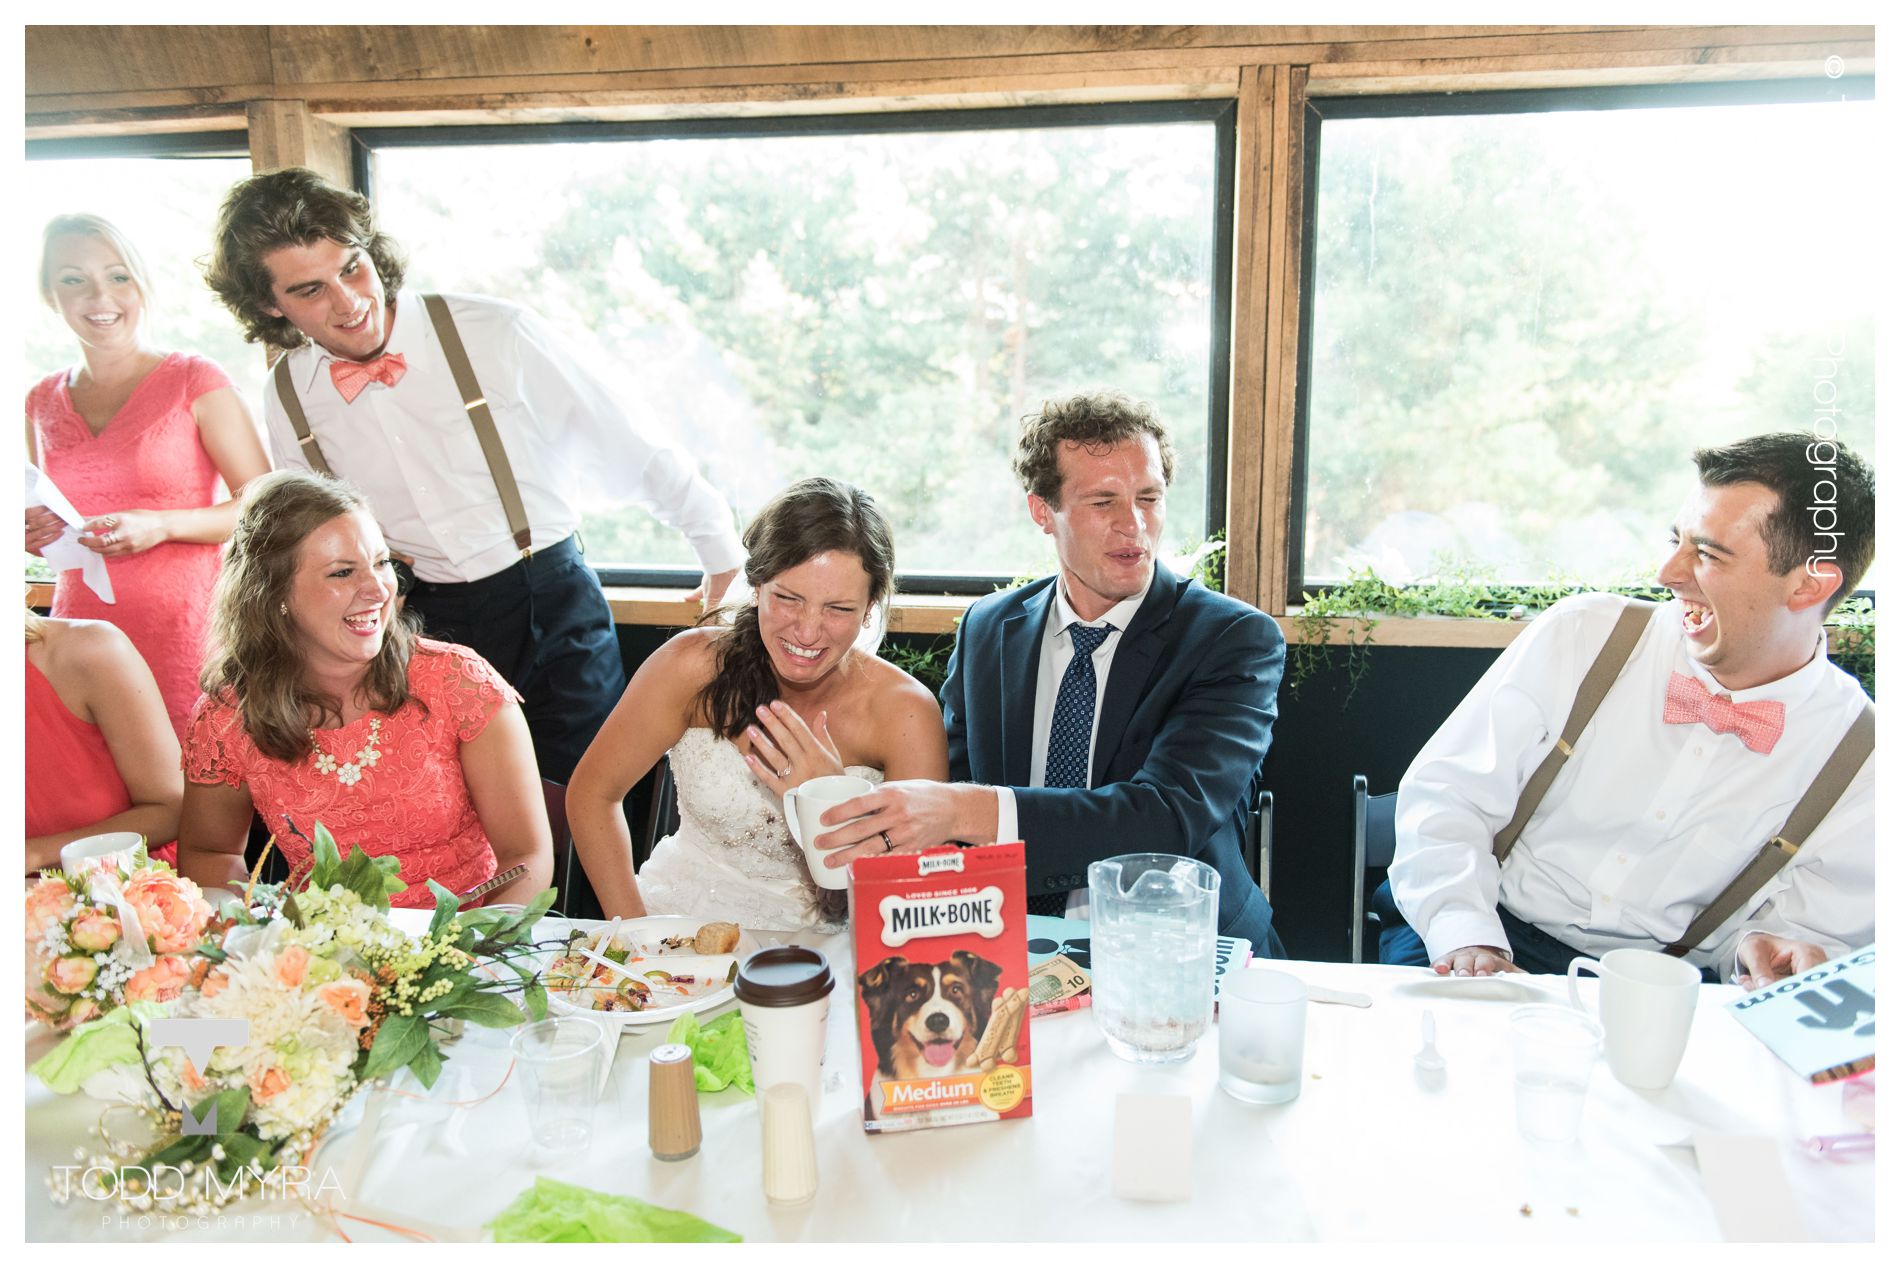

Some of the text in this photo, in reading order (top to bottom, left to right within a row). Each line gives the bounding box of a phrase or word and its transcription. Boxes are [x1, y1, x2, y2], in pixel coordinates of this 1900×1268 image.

[933, 888, 958, 897] SINCE
[1067, 975, 1085, 988] 10
[892, 1080, 975, 1105] Medium
